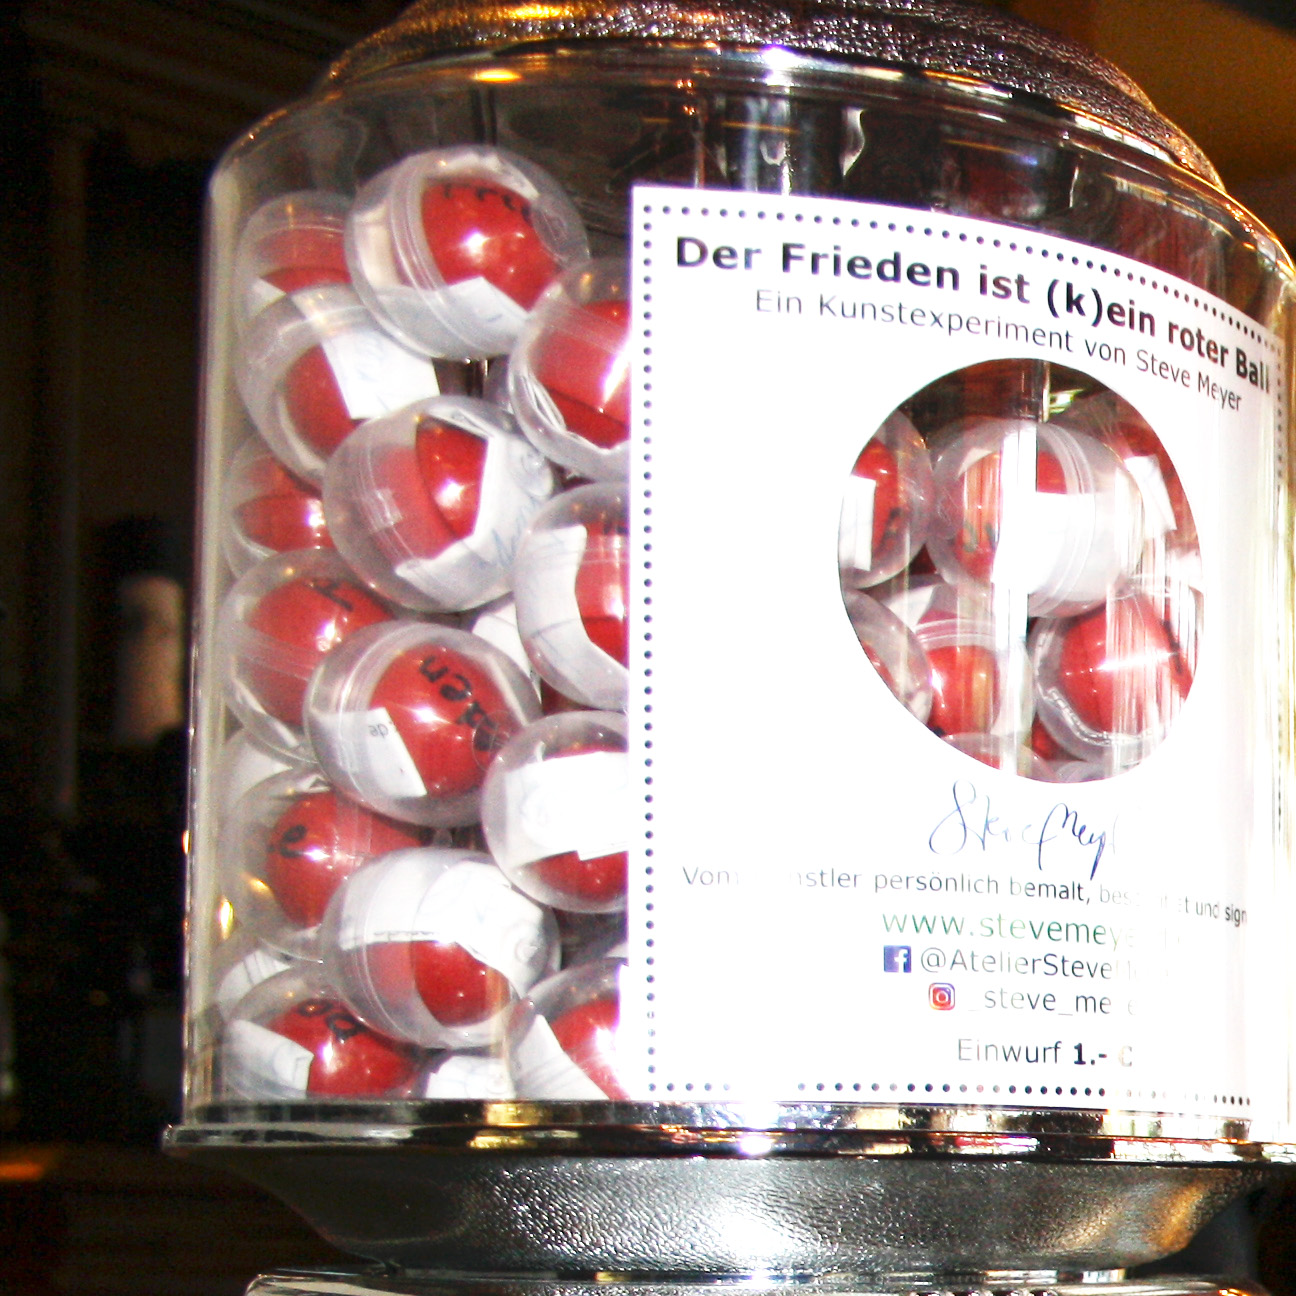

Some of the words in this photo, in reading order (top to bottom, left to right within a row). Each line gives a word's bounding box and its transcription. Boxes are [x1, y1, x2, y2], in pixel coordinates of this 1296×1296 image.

[676, 235, 762, 271] Der
[782, 242, 961, 292] Frieden
[979, 263, 1031, 304] ist
[1046, 278, 1156, 337] (k)ein
[1167, 320, 1230, 368] roter
[1235, 347, 1270, 394] Ball
[756, 288, 803, 315] Ein
[819, 293, 1074, 353] Kunstexperiment
[1084, 338, 1127, 366] von
[1135, 349, 1191, 388] Steve
[1197, 371, 1242, 412] Meyer
[874, 871, 999, 894] persönlich
[1010, 875, 1091, 906] bemalt,
[958, 1038, 1063, 1065] Einwurf
